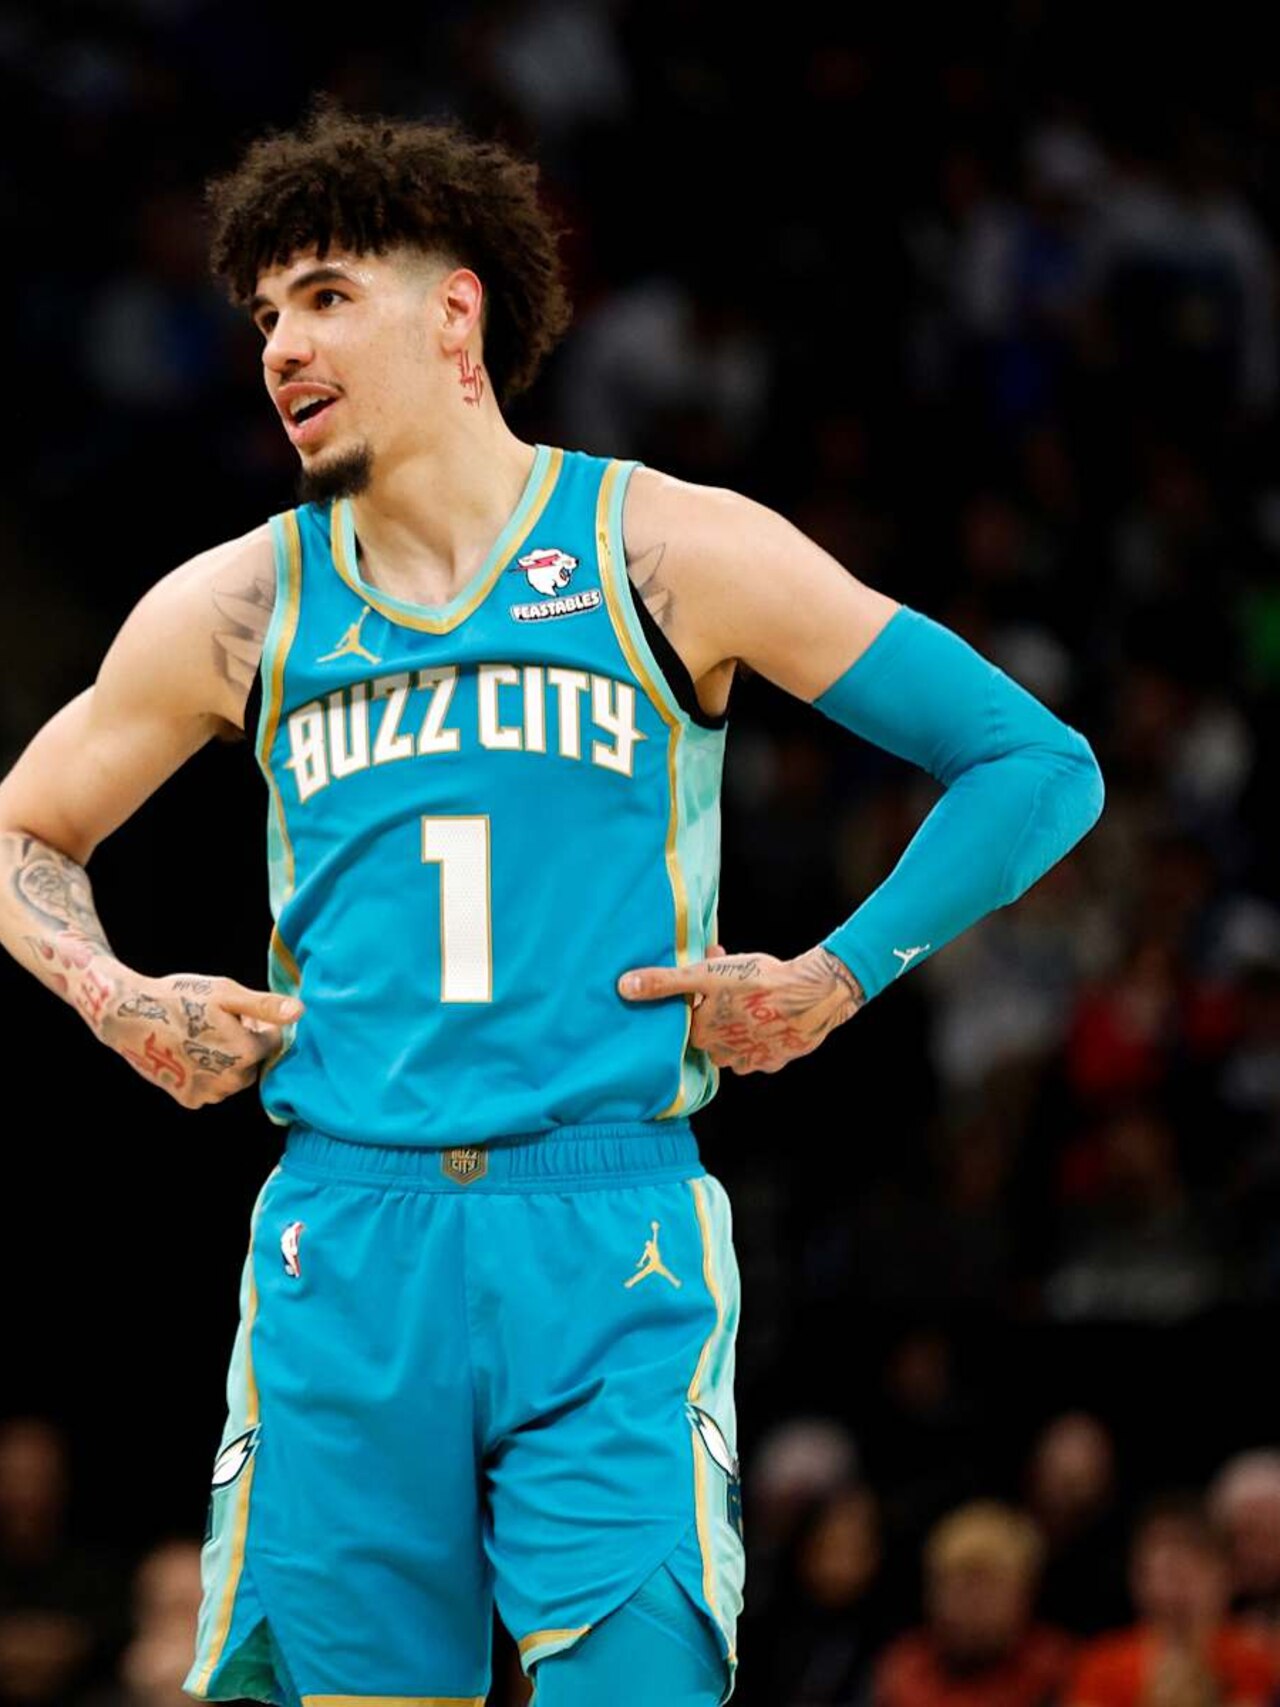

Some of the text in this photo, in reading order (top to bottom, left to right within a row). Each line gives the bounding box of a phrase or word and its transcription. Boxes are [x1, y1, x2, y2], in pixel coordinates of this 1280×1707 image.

[512, 591, 600, 620] FEASTABLES
[283, 664, 648, 804] BUZZ CITY
[420, 815, 493, 1004] 1
[451, 1160, 477, 1174] CITY
